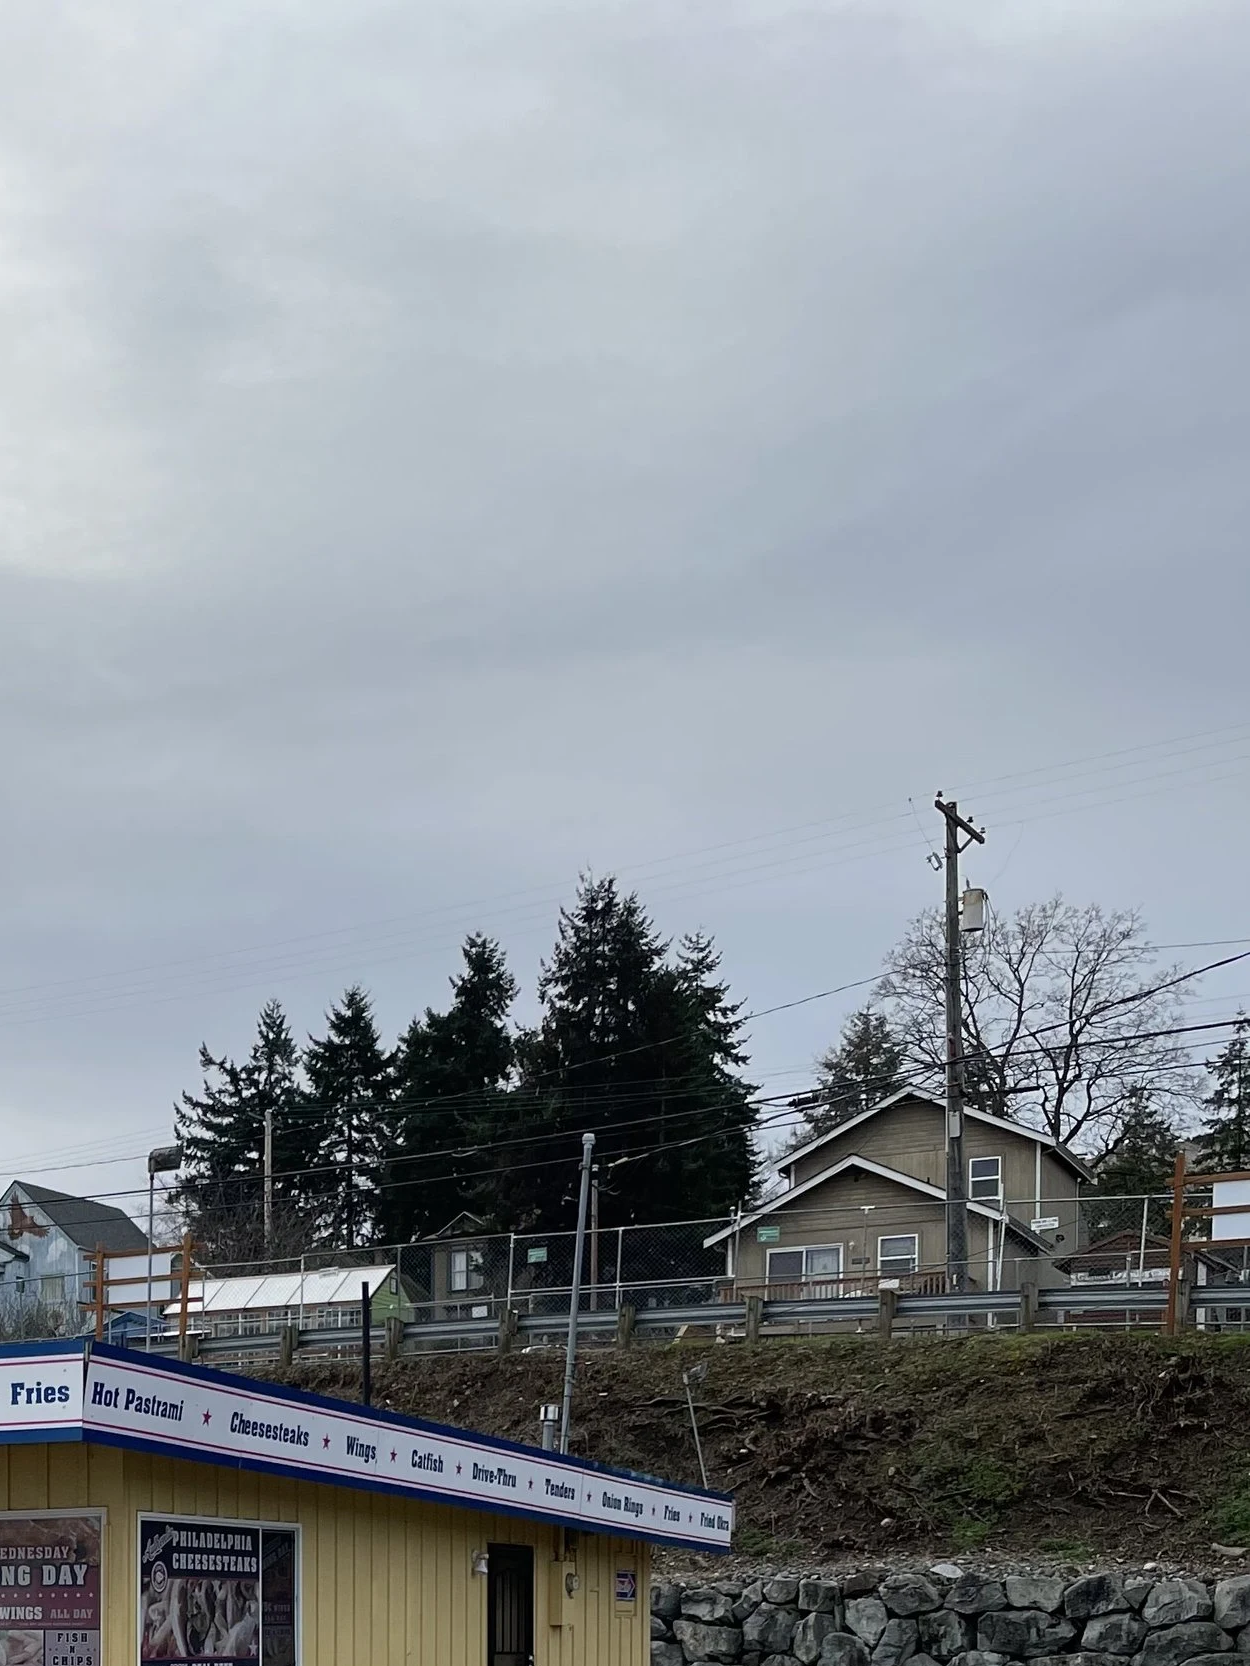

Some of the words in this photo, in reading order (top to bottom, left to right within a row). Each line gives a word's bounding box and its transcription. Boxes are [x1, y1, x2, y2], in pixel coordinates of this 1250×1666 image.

[11, 1381, 70, 1405] Fries
[91, 1382, 120, 1408] Hot
[124, 1388, 184, 1422] Pastrami
[230, 1411, 309, 1447] Cheesesteaks
[346, 1435, 377, 1463] Wings
[411, 1449, 444, 1474] Catfish
[472, 1462, 517, 1488] Drive-Thru
[545, 1478, 575, 1500] Tenders
[602, 1491, 622, 1512] Onion
[623, 1496, 644, 1516] Rings
[663, 1505, 680, 1523] Fries
[700, 1512, 715, 1530] Fried
[716, 1515, 729, 1532] Okra
[172, 1530, 252, 1551] PHILADELPHIA
[172, 1553, 257, 1573] CHEESESTEAKS
[42, 1563, 89, 1585] DAY
[50, 1609, 70, 1619] ALL
[73, 1609, 93, 1619] DAY
[57, 1632, 88, 1643] FISH
[52, 1656, 93, 1666] CHIPS
